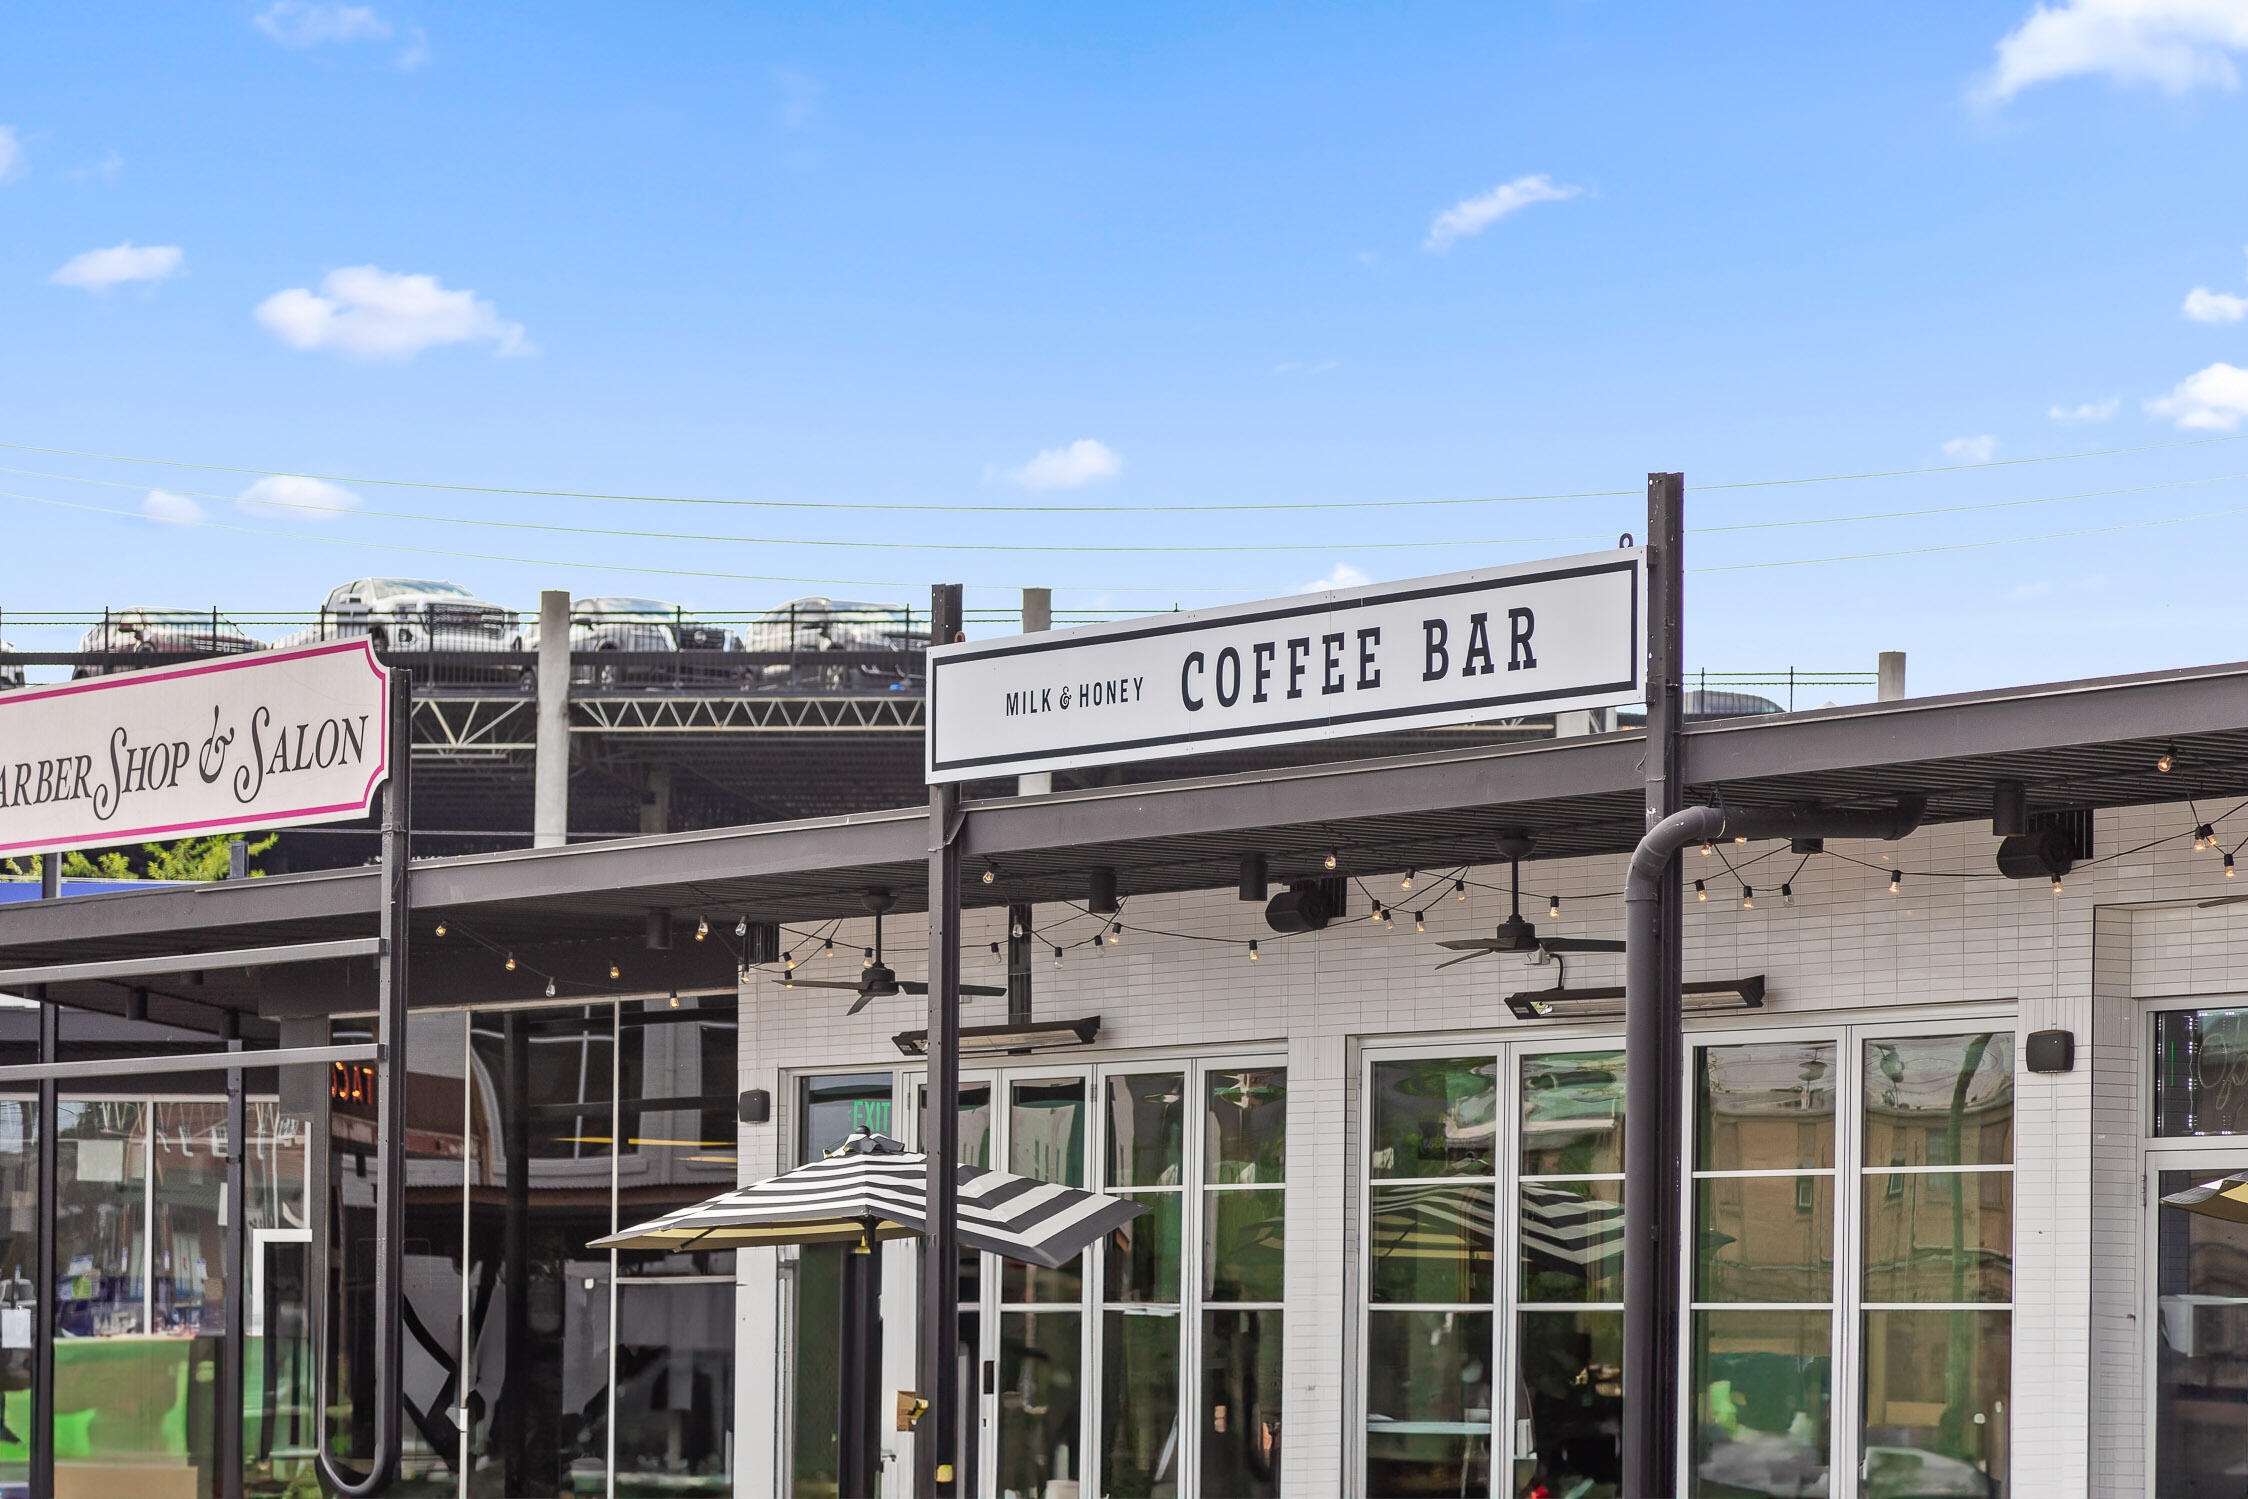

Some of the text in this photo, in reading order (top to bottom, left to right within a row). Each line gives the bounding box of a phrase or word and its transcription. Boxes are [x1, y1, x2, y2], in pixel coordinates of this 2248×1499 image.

[1005, 606, 1537, 717] MILK & HONEY COFFEE BAR
[199, 704, 235, 784] &
[853, 1100, 892, 1132] EXIT
